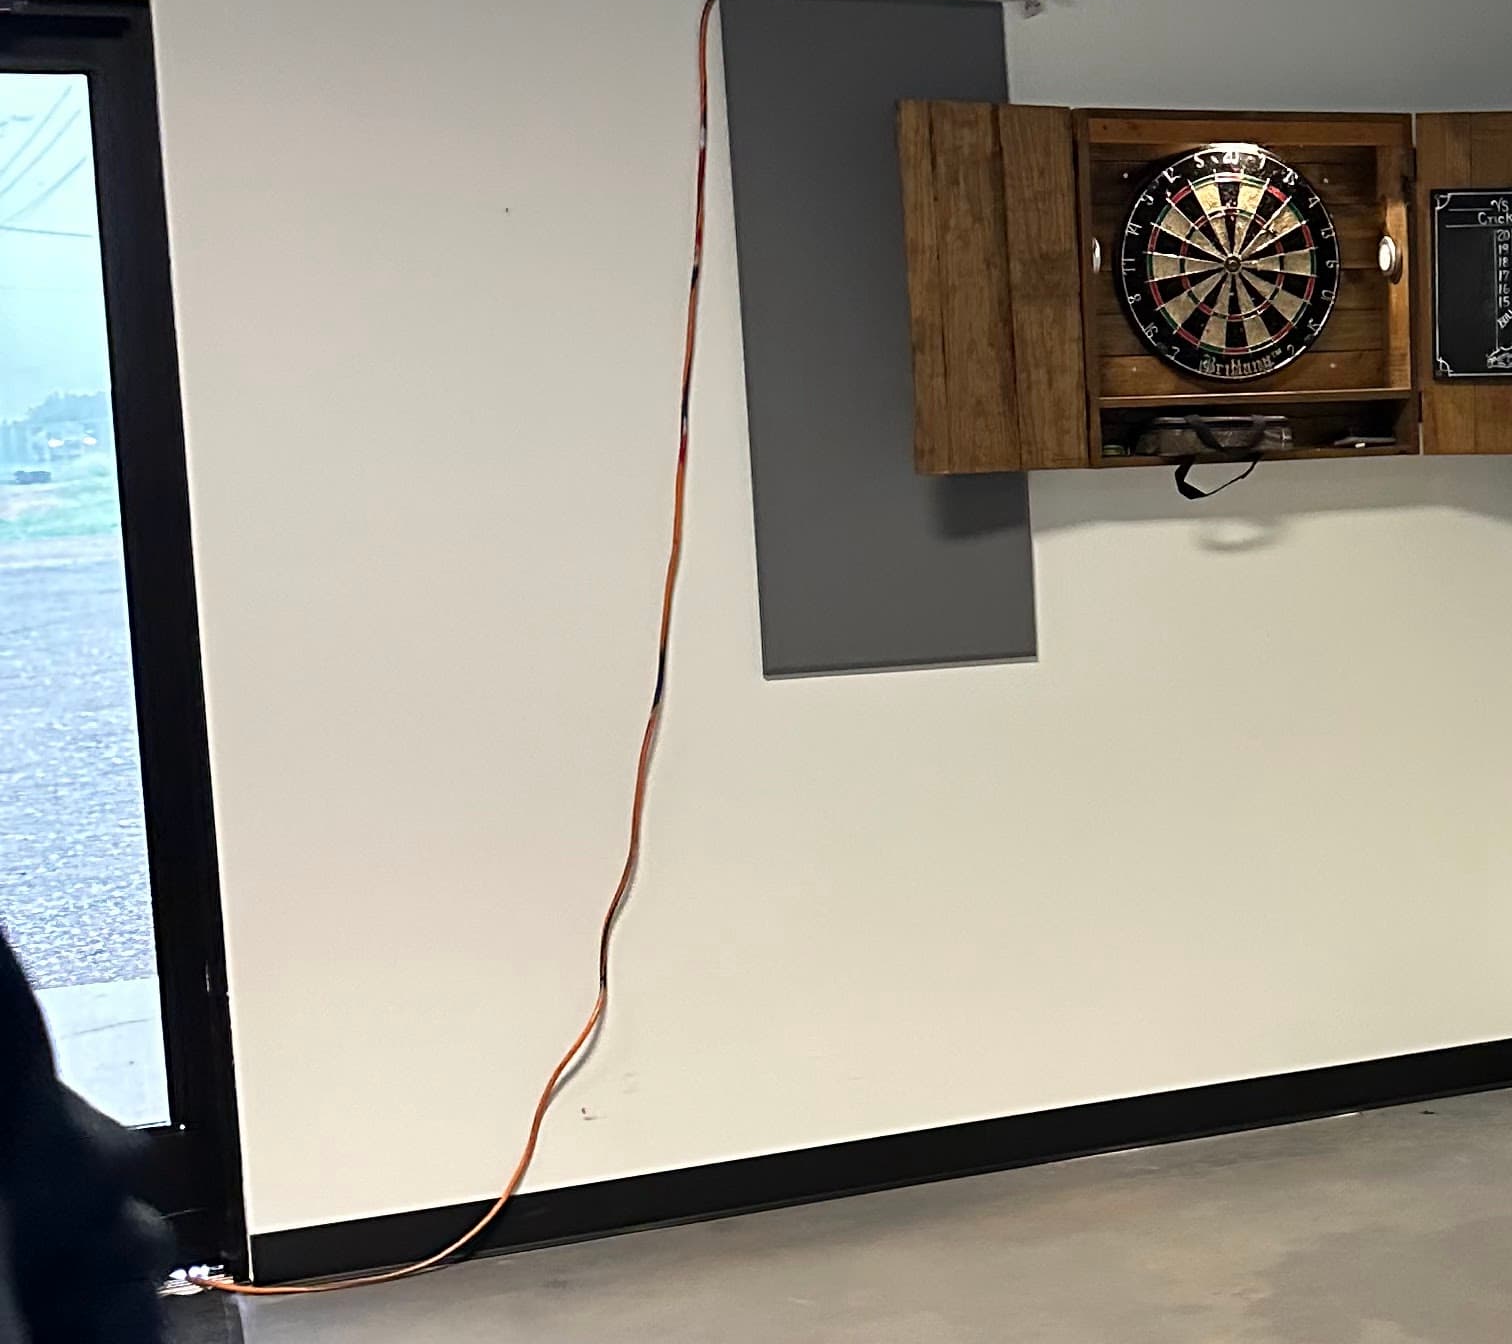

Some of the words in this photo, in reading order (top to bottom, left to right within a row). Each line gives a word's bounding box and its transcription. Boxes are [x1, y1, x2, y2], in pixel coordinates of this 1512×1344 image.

[1194, 156, 1206, 169] 5
[1497, 229, 1511, 242] 20
[1498, 243, 1510, 255] 19
[1498, 256, 1510, 268] 18
[1498, 269, 1510, 282] 17
[1498, 283, 1511, 295] 16
[1498, 296, 1511, 308] 15
